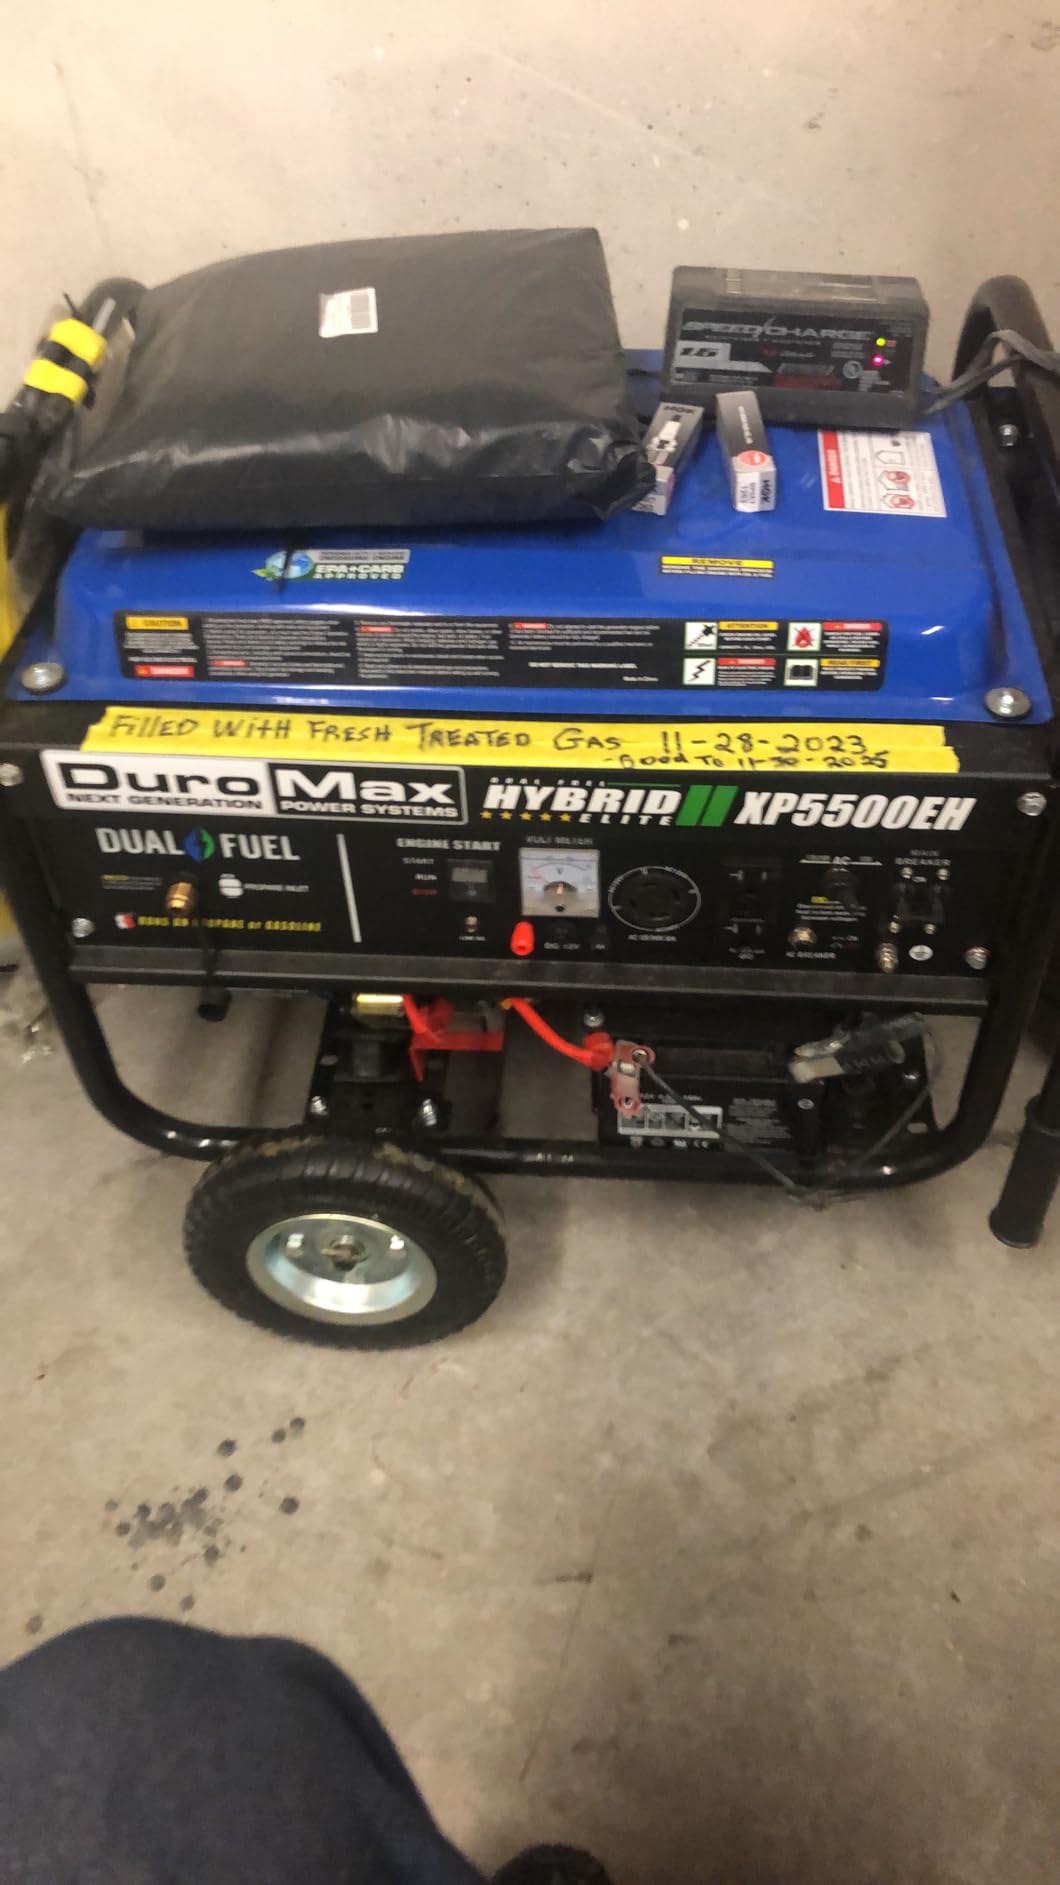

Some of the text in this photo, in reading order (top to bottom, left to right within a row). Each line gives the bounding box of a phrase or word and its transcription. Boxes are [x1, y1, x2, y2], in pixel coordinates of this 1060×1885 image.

[305, 719, 392, 744] FRESH
[407, 722, 532, 750] TREATED
[67, 793, 458, 817] NEXT GENERATION POWER SYSTEMS
[482, 784, 682, 815] HYBRID
[734, 791, 978, 832] XP5500EH
[578, 813, 674, 826] ELITE
[95, 827, 301, 861] DUAL FUEL
[396, 837, 500, 851] ENGINE START
